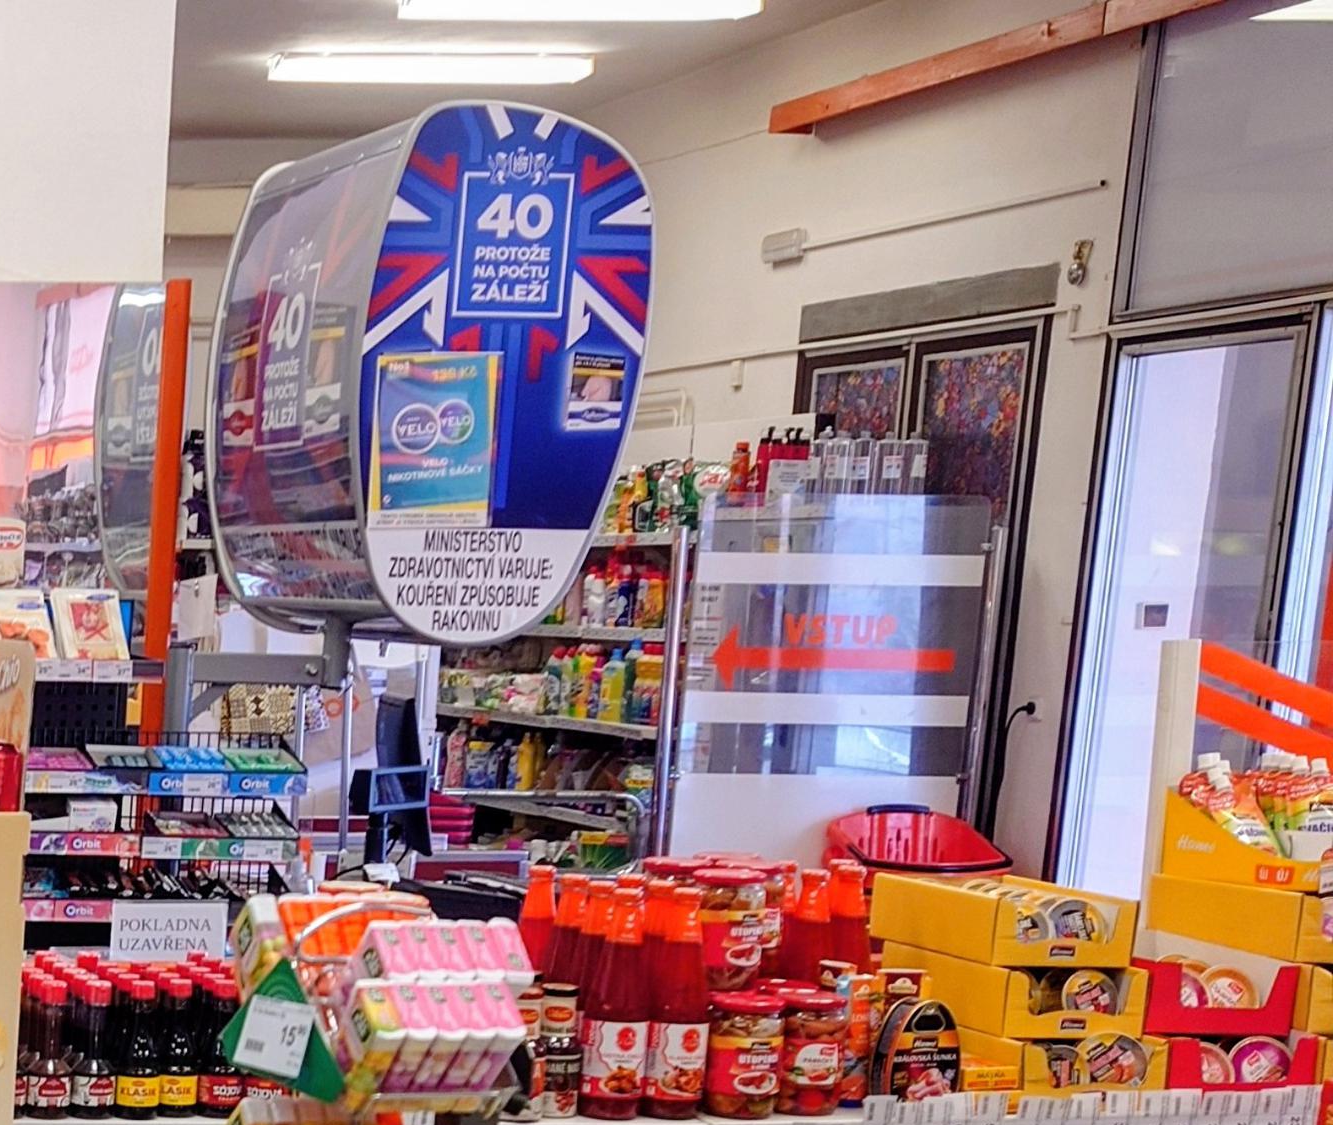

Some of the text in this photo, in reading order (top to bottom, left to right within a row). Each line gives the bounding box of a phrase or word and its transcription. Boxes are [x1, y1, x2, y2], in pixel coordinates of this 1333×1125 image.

[477, 193, 554, 240] 40
[473, 243, 552, 262] PROTOŽE
[473, 262, 550, 279] NA POČTU
[470, 279, 549, 303] ZÁLEŽÍ
[267, 291, 306, 352] 40
[397, 421, 437, 437] VELO
[441, 413, 471, 428] VELO
[423, 530, 523, 553] MINISTERSTVO
[388, 554, 555, 580] ZDRAVOTNICTVÍ VARUJE:
[396, 580, 541, 608] KOUŘENÍ ZPŮSOBUJE
[431, 610, 502, 632] RAKOVINU
[784, 613, 897, 646] VSTUP
[160, 776, 184, 790] Orb
[241, 777, 271, 791] Orbit
[72, 837, 102, 850] Orbit
[64, 903, 94, 917] Orbit
[119, 917, 213, 932] POKLADNA
[119, 936, 209, 952] UZAVŘENA
[120, 1086, 156, 1098] KLASIK
